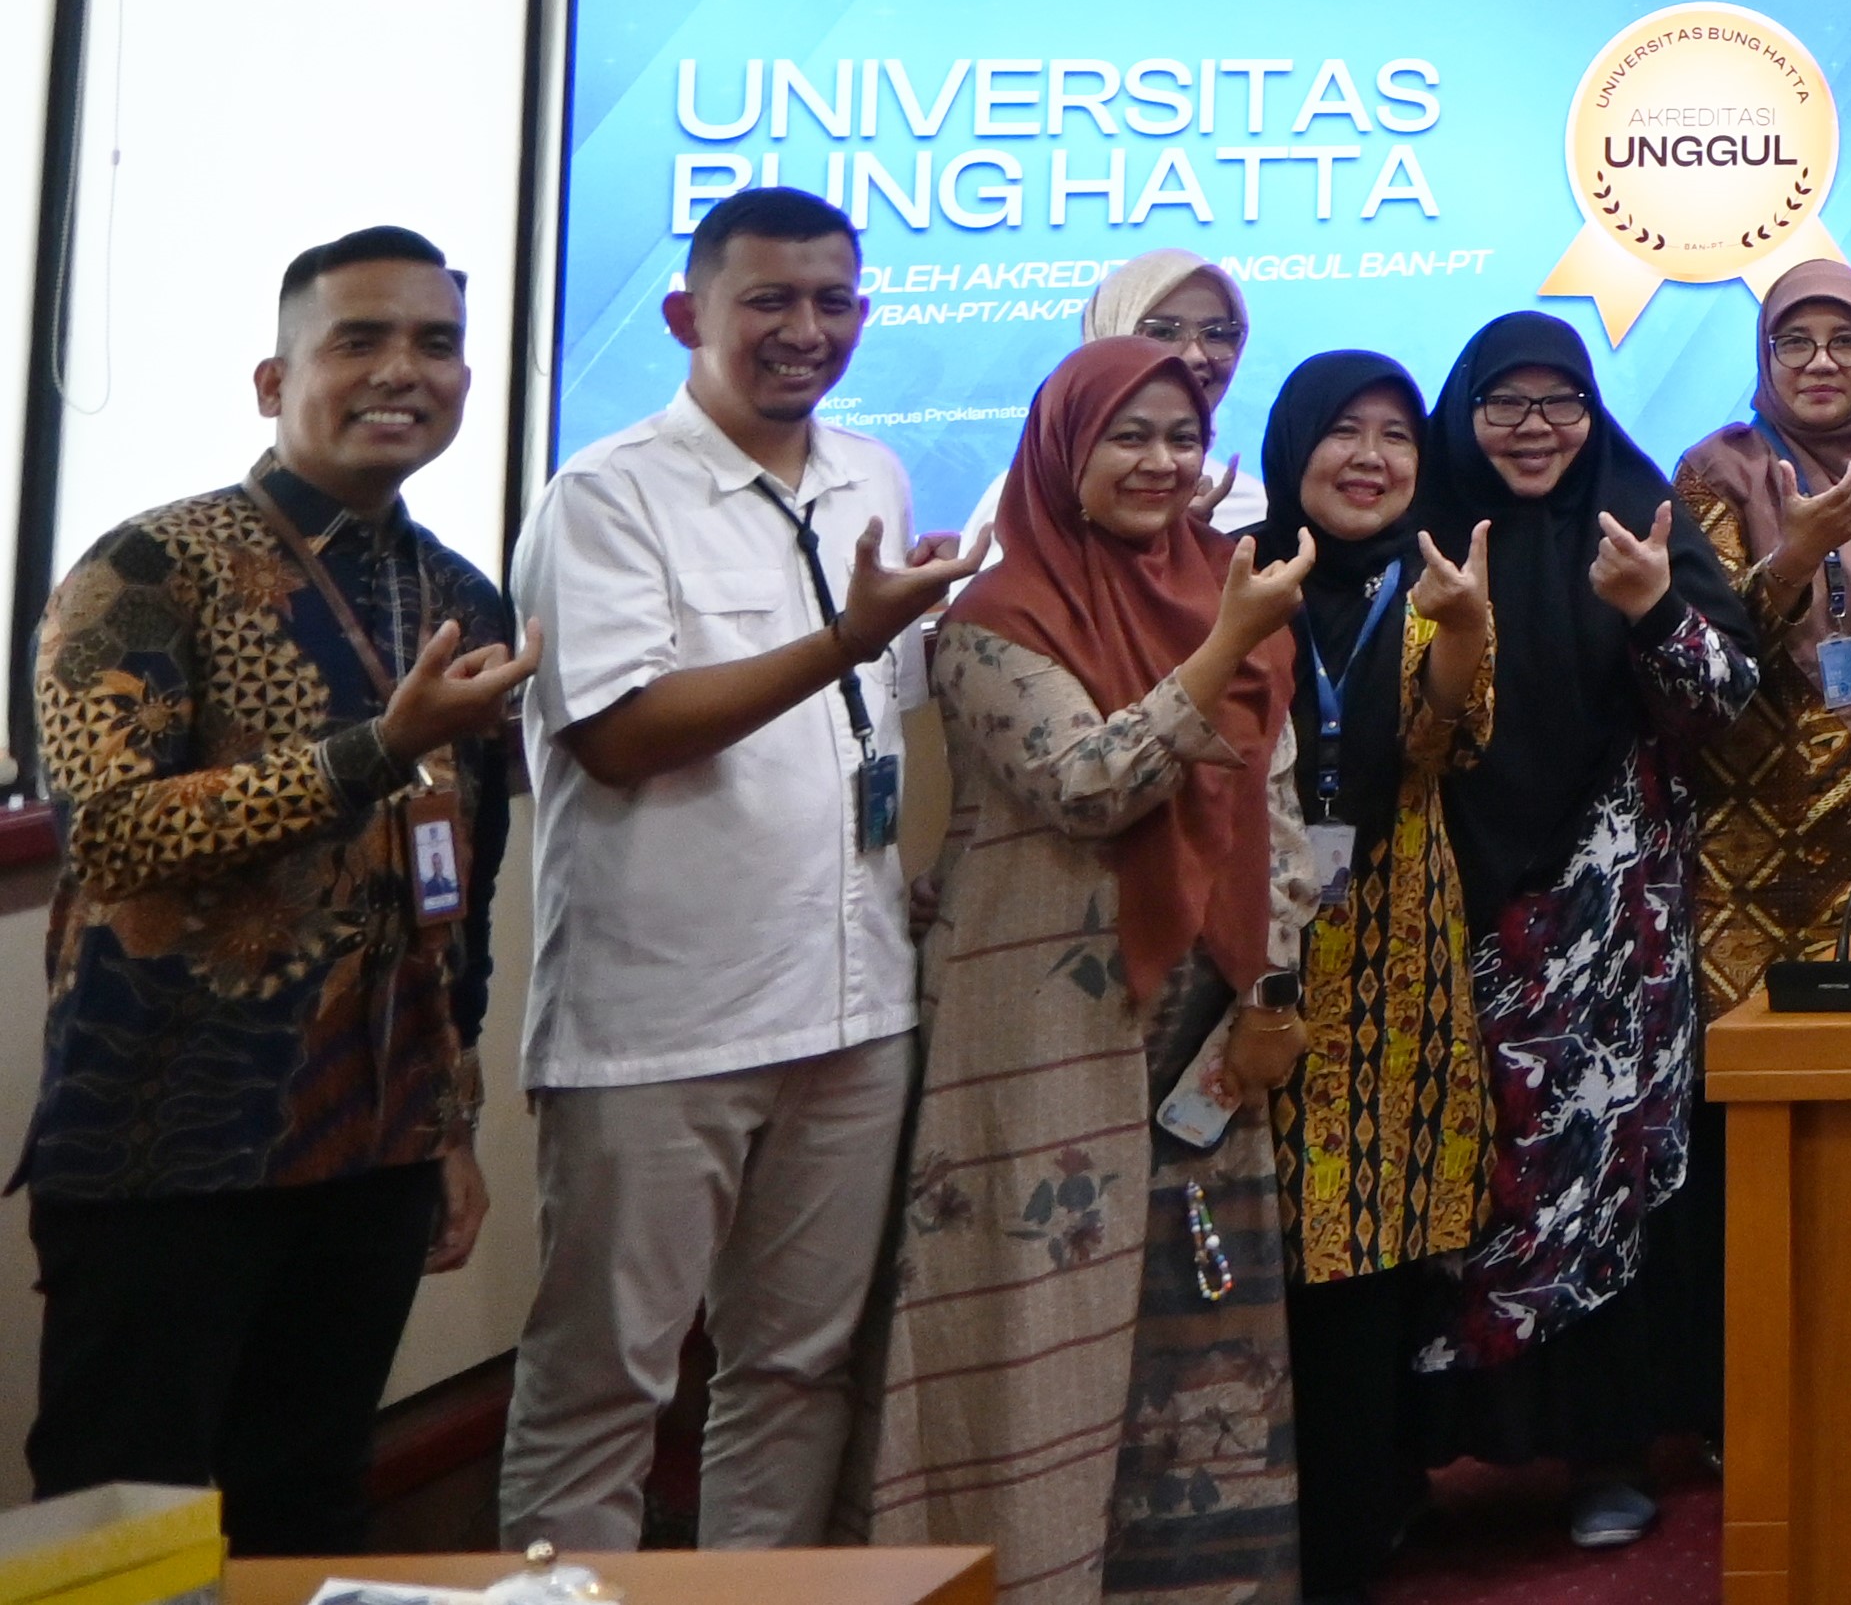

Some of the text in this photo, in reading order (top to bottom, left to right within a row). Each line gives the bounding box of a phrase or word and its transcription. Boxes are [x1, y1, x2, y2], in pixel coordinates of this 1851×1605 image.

[1596, 26, 1810, 109] UNIVERSITAS BUNG HATTA
[677, 57, 1441, 140] UNIVERSITAS
[1628, 107, 1776, 127] AKREDITASI
[1604, 134, 1798, 168] UNGGUL
[1047, 144, 1441, 228] HATTA
[963, 259, 1129, 291] AKREDI
[1203, 253, 1352, 283] NGGUL
[1358, 248, 1494, 279] BAN-PT
[846, 410, 922, 427] Kampus
[924, 404, 1029, 422] Proklamato
